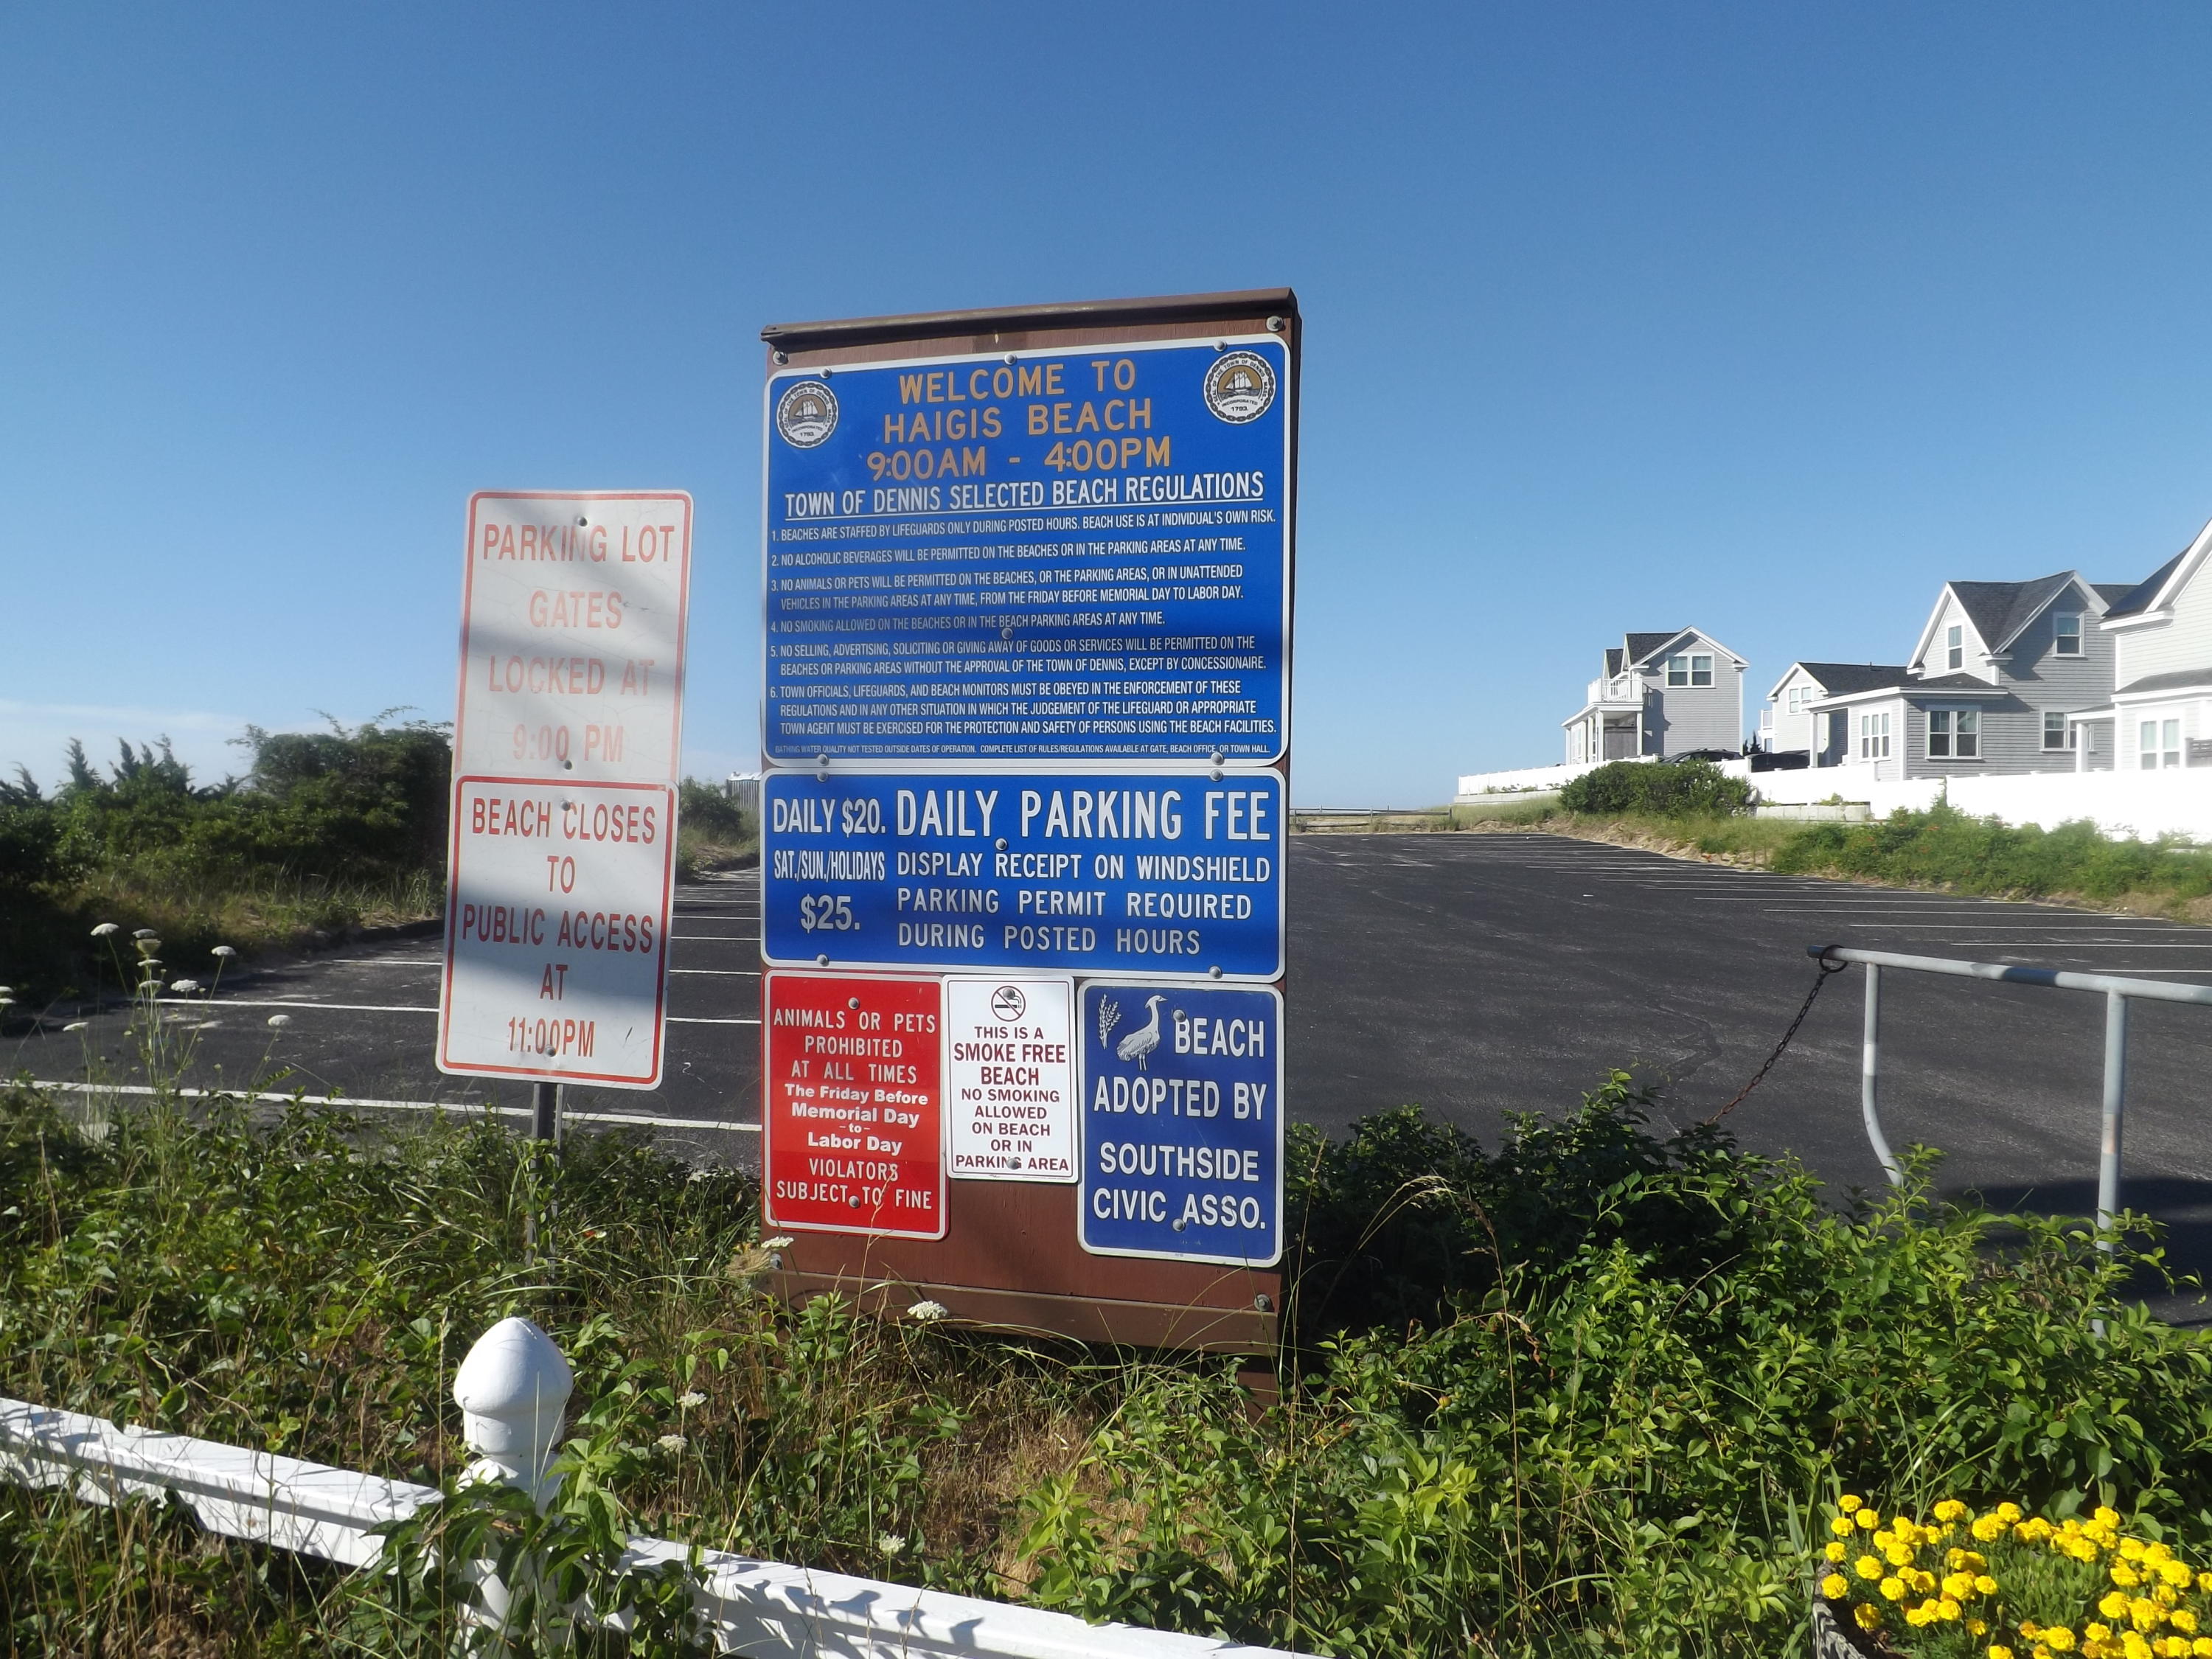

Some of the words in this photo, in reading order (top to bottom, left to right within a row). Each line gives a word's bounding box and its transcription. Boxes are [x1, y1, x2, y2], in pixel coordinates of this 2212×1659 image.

[899, 364, 1064, 404] WELCOME
[1092, 359, 1135, 391] TO
[886, 407, 1002, 444] HAIGIS
[1028, 399, 1152, 435] BEACH
[866, 448, 986, 481] 9:00AM
[1044, 437, 1170, 472] 4:00PM
[785, 492, 835, 516] TOWN
[841, 490, 865, 513] OF
[874, 487, 941, 512] DENNIS
[950, 482, 1044, 509] SELECTED
[1053, 478, 1117, 504] BEACH
[1125, 472, 1264, 501] REGULATIONS
[782, 528, 818, 540] BEACHES
[821, 526, 838, 540] ARE
[840, 525, 877, 538] STAFFED
[879, 524, 890, 537] BY
[892, 522, 945, 536] LIFEGUARDS
[948, 521, 970, 535] ONLY
[973, 520, 1006, 534] DURING
[1009, 518, 1043, 532] POSTED
[1046, 517, 1080, 530] HOURS.
[1083, 515, 1113, 529] BEACH
[1116, 515, 1133, 528] USE
[1136, 514, 1145, 526] IS
[1148, 514, 1159, 526] AT
[1163, 511, 1222, 525] INDIVIDUAL'S
[1225, 510, 1248, 524] OWN
[1251, 509, 1276, 522] RISK.
[484, 524, 606, 562] PARKING
[622, 526, 675, 563] LOT
[782, 554, 793, 566] NO
[796, 552, 841, 565] ALCOHOLIC
[844, 550, 892, 564] BEVERAGES
[894, 549, 915, 562] WILL
[918, 549, 928, 561] BE
[931, 546, 980, 560] PERMITTED
[983, 546, 995, 558] ON
[998, 546, 1015, 558] THE
[1018, 544, 1058, 557] BEACHES
[1061, 543, 1073, 556] OR
[1077, 543, 1085, 555] IN
[1088, 542, 1105, 554] THE
[1108, 540, 1147, 554] PARKING
[1150, 540, 1180, 553] AREAS
[1183, 539, 1195, 552] AT
[1198, 538, 1217, 551] ANY
[1220, 538, 1245, 550] TIME.
[529, 591, 622, 629] GATES
[489, 655, 605, 695] LOCKED
[620, 659, 654, 696] AT
[781, 704, 837, 717] REGULATIONS
[840, 705, 857, 716] AND
[860, 704, 868, 715] IN
[870, 704, 888, 715] ANY
[890, 703, 918, 715] OTHER
[921, 703, 965, 715] SITUATION
[968, 703, 976, 714] IN
[979, 703, 1008, 714] WHICH
[1011, 703, 1028, 714] THE
[1031, 702, 1085, 714] JUDGEMENT
[1088, 702, 1100, 714] OF
[1102, 702, 1119, 714] THE
[1123, 701, 1173, 714] LIFEGUARD
[1176, 701, 1189, 713] OR
[1192, 700, 1256, 713] APPROPRIATE
[513, 724, 569, 761] 9:00
[585, 725, 623, 762] PM
[781, 723, 805, 734] TOWN
[807, 723, 835, 734] AGENT
[837, 723, 860, 734] MUST
[863, 723, 874, 734] BE
[877, 722, 922, 734] EXERCISED
[925, 722, 942, 734] FOR
[945, 722, 961, 733] THE
[964, 721, 1018, 734] PROTECTION
[1021, 721, 1040, 734] AND
[1043, 721, 1076, 734] SAFETY
[1079, 721, 1091, 733] OF
[1093, 720, 1136, 733] PERSONS
[1138, 720, 1166, 733] USING
[1169, 720, 1187, 732] THE
[1190, 720, 1222, 732] BEACH
[1225, 720, 1276, 732] FACILITIES.
[472, 798, 551, 838] BEACH
[564, 802, 655, 844] CLOSES
[773, 799, 835, 834] DAILY
[841, 798, 886, 838] $20.
[897, 790, 999, 838] DAILY
[1021, 790, 1181, 839] PARKING
[1206, 791, 1270, 841] FEE
[547, 856, 575, 894] TO
[897, 852, 982, 877] DISPLAY
[995, 853, 1082, 879] RECEIPT
[1094, 855, 1123, 879] ON
[1137, 856, 1270, 883] WINDSHIELD
[800, 894, 860, 934] $25.
[897, 888, 999, 914] PARKING
[1018, 890, 1106, 917] PERMIT
[1127, 892, 1251, 920] REQUIRED
[462, 904, 545, 945] PUBLIC
[557, 910, 653, 954] ACCESS
[898, 923, 984, 948] DURING
[1004, 925, 1096, 953] POSTED
[1117, 928, 1200, 955] HOURS
[540, 963, 568, 1001] AT
[508, 1016, 594, 1057] 11:00PM
[774, 1009, 845, 1029] ANIMALS
[858, 1012, 880, 1030] OR
[894, 1012, 936, 1033] PETS
[975, 1026, 1009, 1040] THIS
[1014, 1027, 1028, 1040] IS
[1033, 1028, 1044, 1040] A
[805, 1036, 902, 1057] PROHIBITED
[953, 1043, 1017, 1062] SMOKE
[1022, 1044, 1066, 1063] FREE
[1175, 1019, 1265, 1057] BEACH
[791, 1060, 811, 1079] AT
[824, 1061, 854, 1081] ALL
[868, 1063, 917, 1084] TIMES
[981, 1066, 1039, 1085] BEACH
[785, 1083, 816, 1098] The
[819, 1086, 869, 1105] Friday
[874, 1090, 928, 1105] Before
[961, 1088, 983, 1101] NO
[987, 1088, 1060, 1103] SMOKING
[1094, 1077, 1220, 1118] ADOPTED
[1234, 1084, 1267, 1120] BY
[791, 1102, 877, 1122] Memorial
[884, 1108, 919, 1128] Day
[975, 1105, 1047, 1119] ALLOWED
[808, 1132, 864, 1152] Labor
[868, 1135, 902, 1156] Day
[972, 1122, 993, 1135] ON
[998, 1122, 1050, 1137] BEACH
[990, 1138, 1012, 1152] OR
[1018, 1140, 1032, 1152] IN
[809, 1158, 899, 1181] VIOLATORS
[1028, 1156, 1068, 1171] AREA
[1100, 1143, 1259, 1182] SOUTHSIDE
[776, 1180, 847, 1203] SUBJECT
[862, 1186, 882, 1206] TO
[895, 1189, 931, 1209] FINE
[1093, 1188, 1166, 1222] CIVIC
[1183, 1195, 1265, 1230] ASSO.
